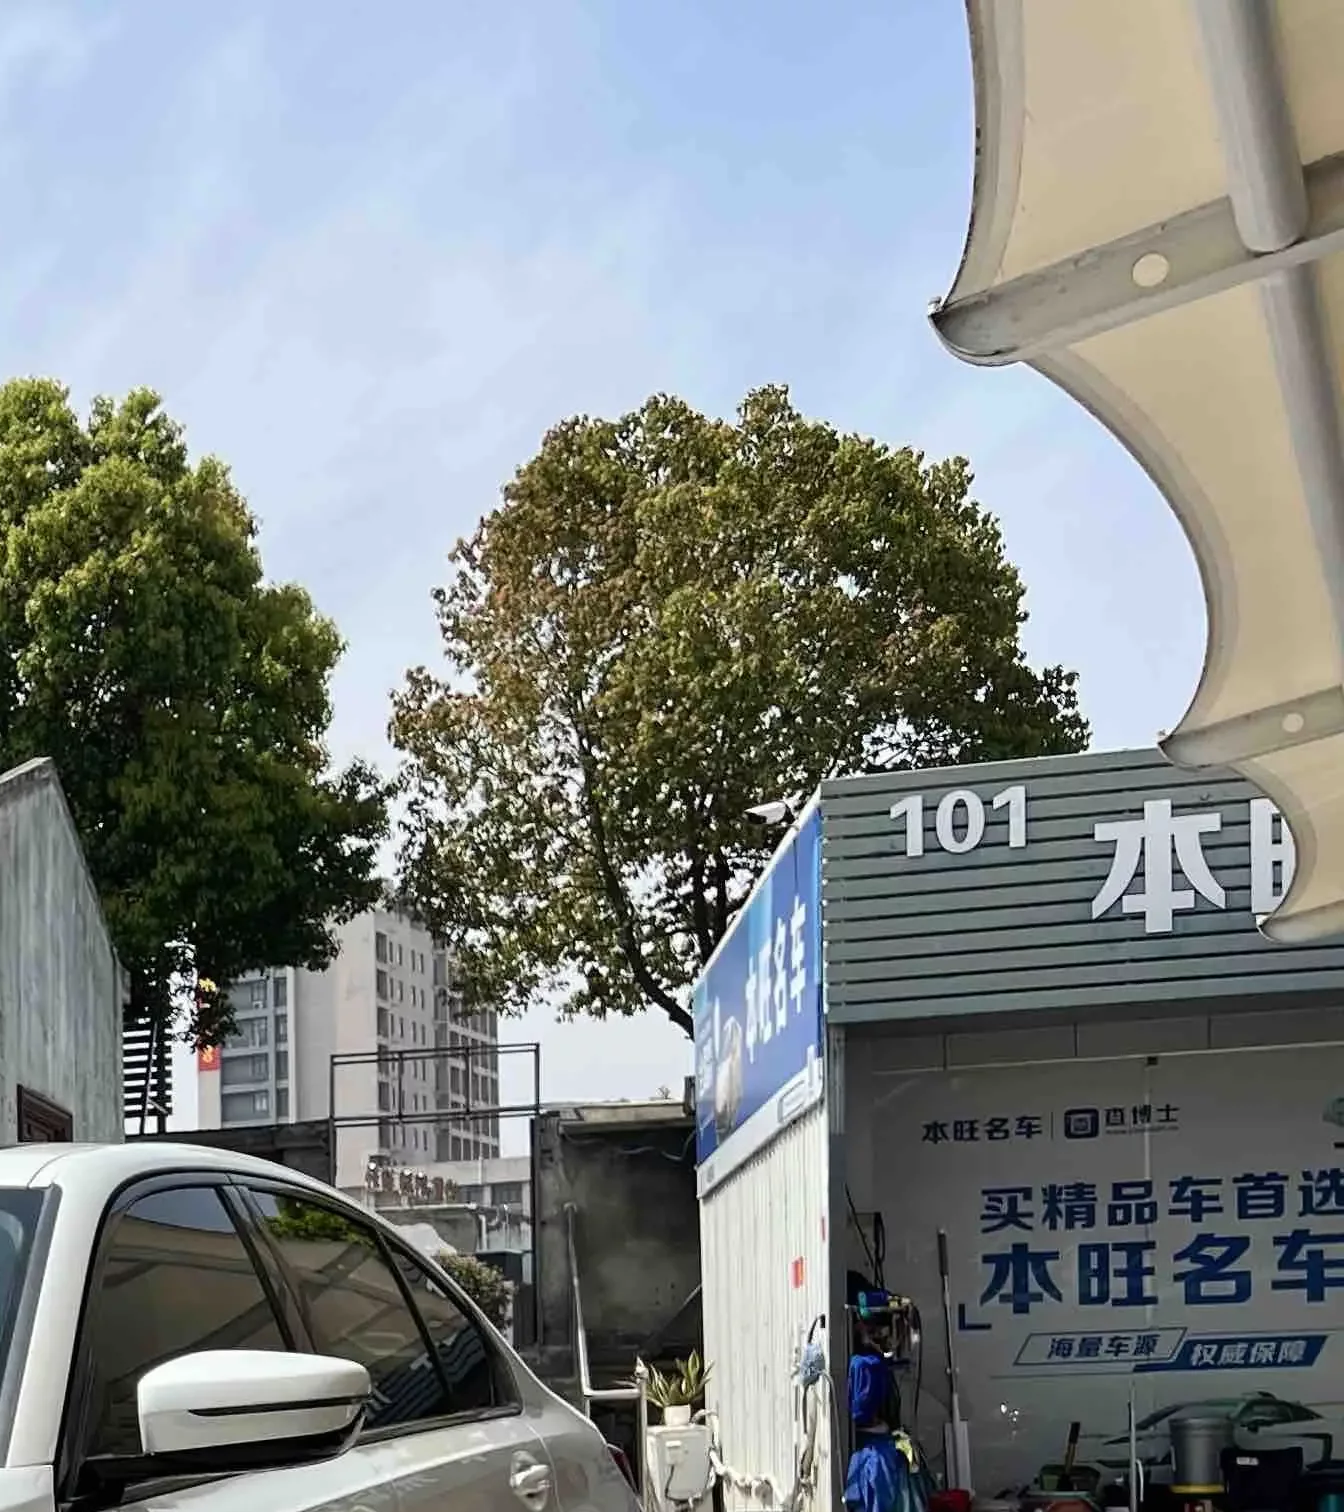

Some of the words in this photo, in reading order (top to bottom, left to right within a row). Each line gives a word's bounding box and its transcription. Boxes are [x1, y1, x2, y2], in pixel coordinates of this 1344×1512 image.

[890, 785, 1026, 857] 101
[745, 894, 807, 1064] 本旺名车
[921, 1115, 1043, 1145] 本旺名车
[979, 1167, 1344, 1234] 买精品车首选
[979, 1228, 1344, 1315] 本旺名车
[1048, 1333, 1162, 1360] 海量车源
[1190, 1340, 1308, 1368] 权威保障
